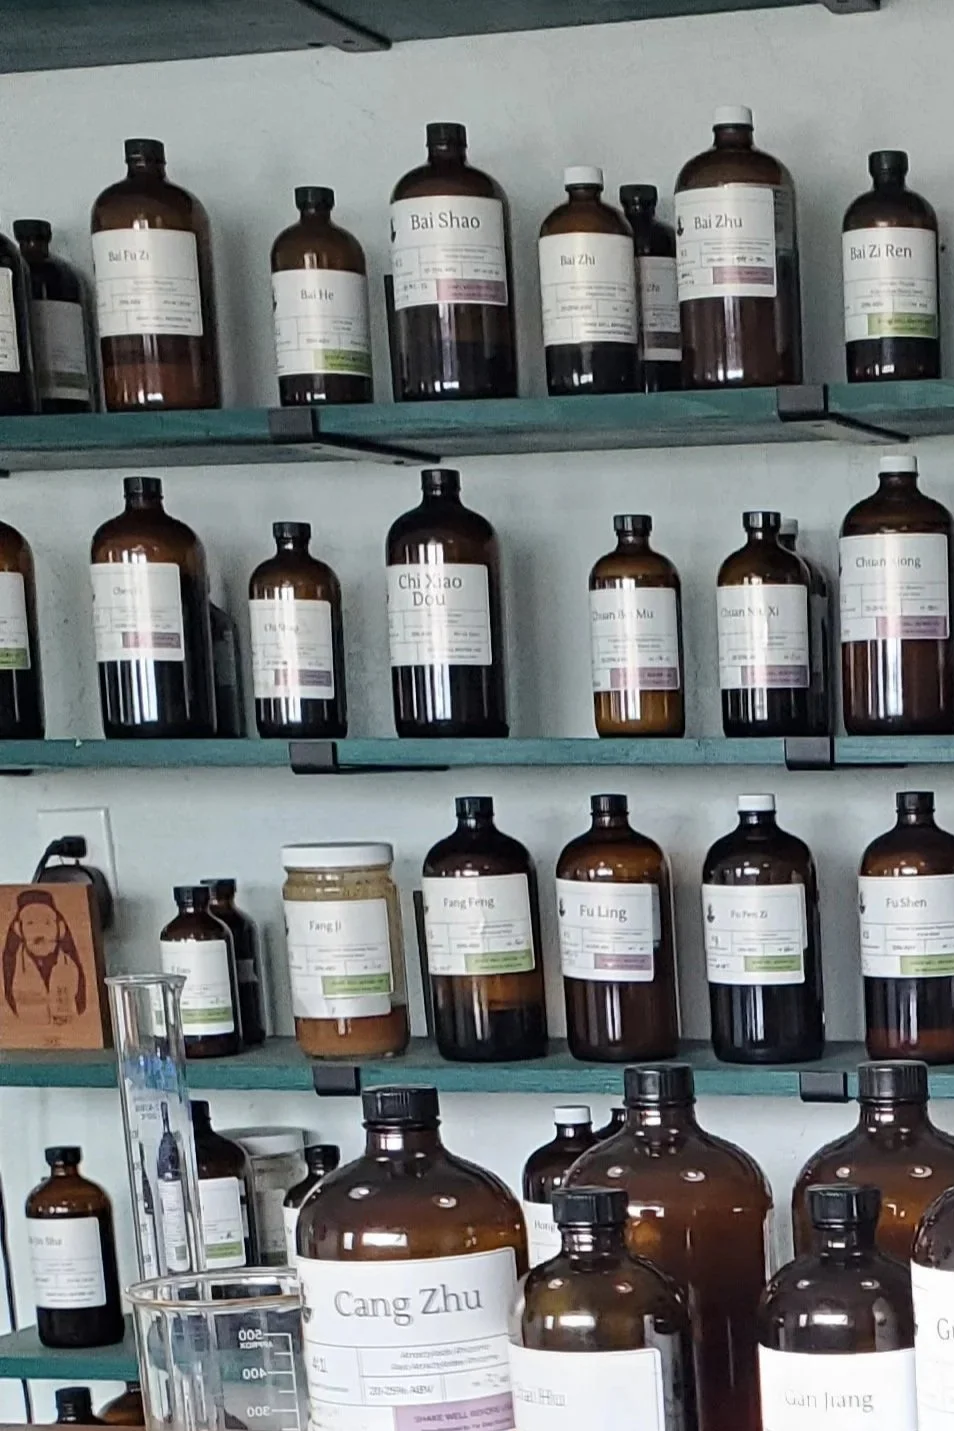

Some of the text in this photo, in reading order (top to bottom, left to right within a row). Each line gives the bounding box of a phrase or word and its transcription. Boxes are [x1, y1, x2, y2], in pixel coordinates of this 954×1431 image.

[410, 211, 481, 231] Bai Shao
[694, 213, 743, 230] Bai Zhu
[108, 249, 122, 262] Bai
[123, 249, 137, 261] Fu
[849, 242, 912, 260] Bai Zi Ren
[560, 253, 596, 266] Bai Zhi
[300, 288, 334, 301] Bai He
[855, 556, 887, 570] Chuan
[398, 573, 463, 590] Chi Xiao
[412, 591, 446, 606] Dou
[636, 608, 654, 621] Mu
[768, 606, 780, 618] Xi
[443, 895, 495, 910] Fang Feng
[885, 896, 928, 909] Fu Shen
[579, 905, 628, 923] Fu Ling
[309, 919, 333, 934] Fang
[333, 1283, 484, 1327] Cang Zhu
[784, 1389, 875, 1413] Gan Jiang
[445, 1410, 467, 1422] WELL
